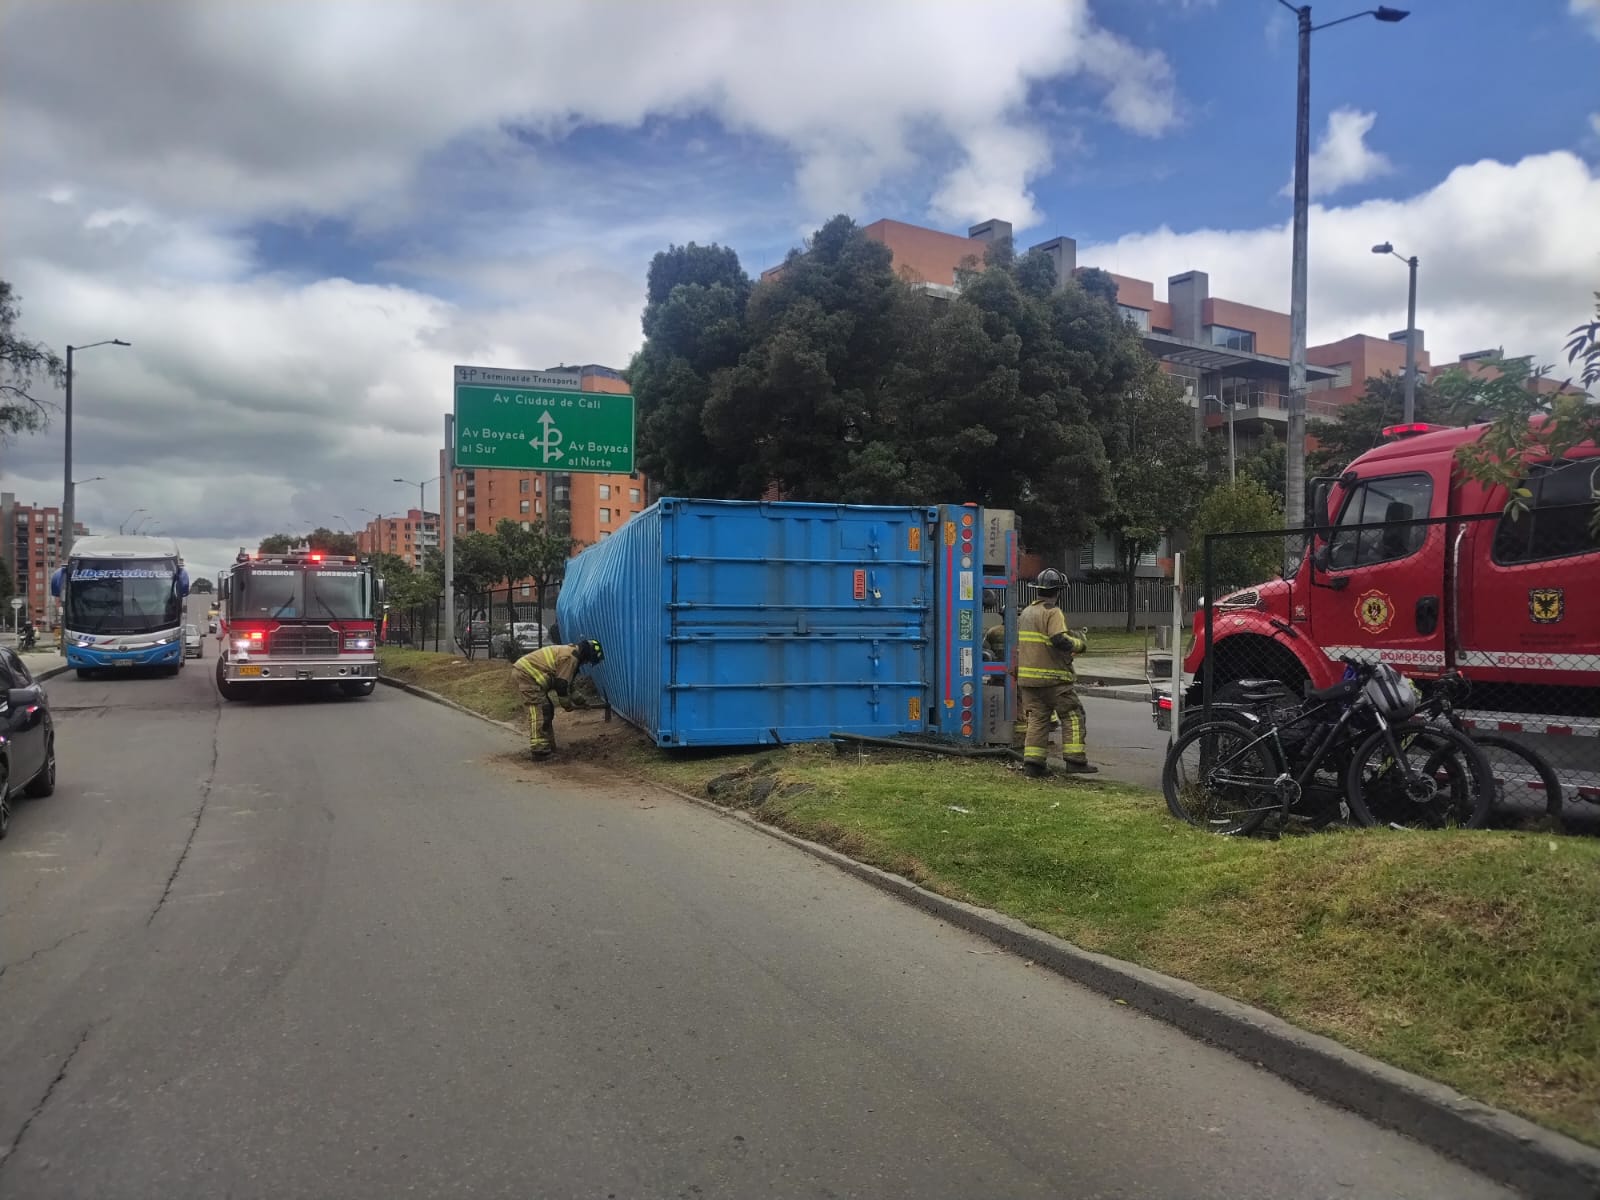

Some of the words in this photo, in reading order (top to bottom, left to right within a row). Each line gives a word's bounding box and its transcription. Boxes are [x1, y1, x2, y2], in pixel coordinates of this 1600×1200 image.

[482, 372, 519, 382] Terminal
[520, 375, 530, 383] de
[532, 375, 578, 386] Transporte
[493, 393, 509, 403] Av
[515, 395, 555, 406] Ciudad
[560, 398, 573, 408] de
[578, 399, 600, 409] Cali
[462, 428, 479, 438] Av
[482, 428, 525, 441] Boyacá
[462, 444, 472, 453] al
[475, 443, 496, 454] Sur
[569, 441, 585, 452] Av
[588, 442, 628, 455] Boyacá
[568, 457, 578, 466] al
[581, 457, 611, 468] Norte
[1380, 652, 1443, 663] BOMBEROS
